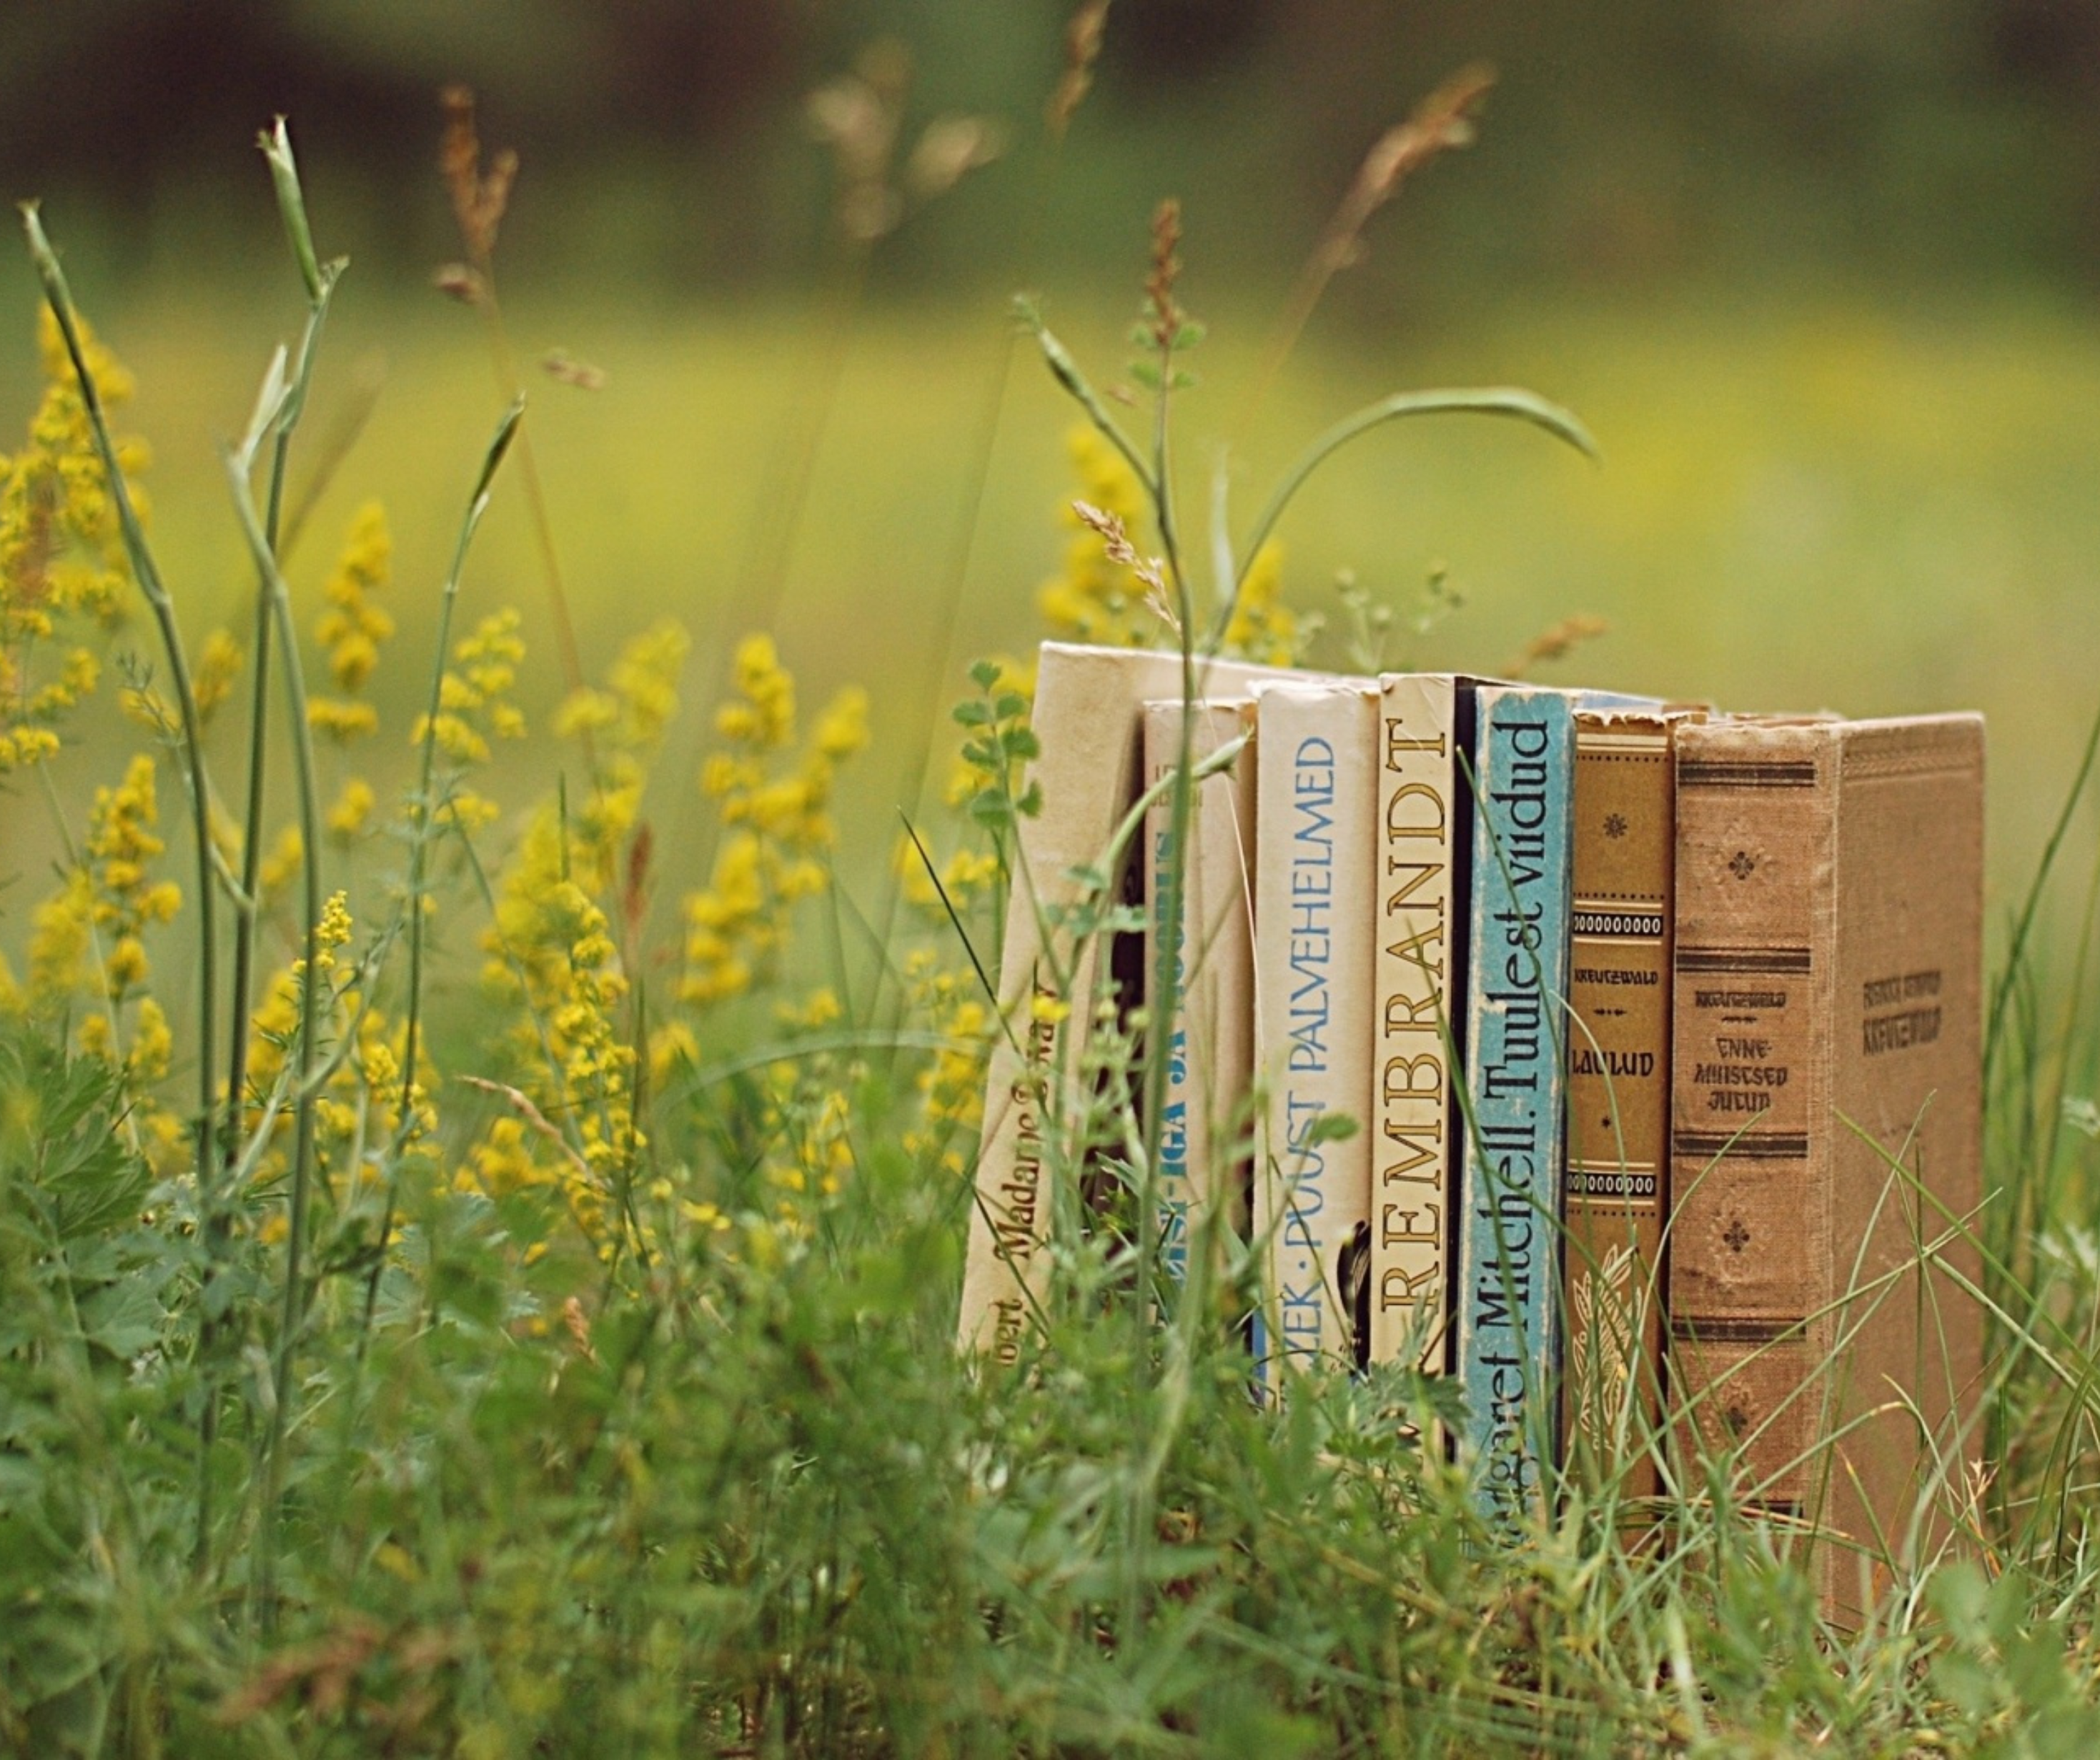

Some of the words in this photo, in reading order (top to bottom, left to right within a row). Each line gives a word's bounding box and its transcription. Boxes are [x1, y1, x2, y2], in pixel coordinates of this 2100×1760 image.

[1490, 722, 1548, 887] viidud
[1288, 736, 1334, 1072] PALVEHELMED
[1575, 969, 1658, 985] KREUTZWALD
[1381, 718, 1445, 1313] REMBRANDT
[1483, 902, 1542, 1099] Tuulest
[1572, 1049, 1654, 1077] LAULUD
[1716, 1038, 1772, 1058] ENNE-
[1284, 1090, 1326, 1247] PUUST
[1707, 1091, 1770, 1112] JUTUD
[1477, 1110, 1535, 1332] Mitchell.
